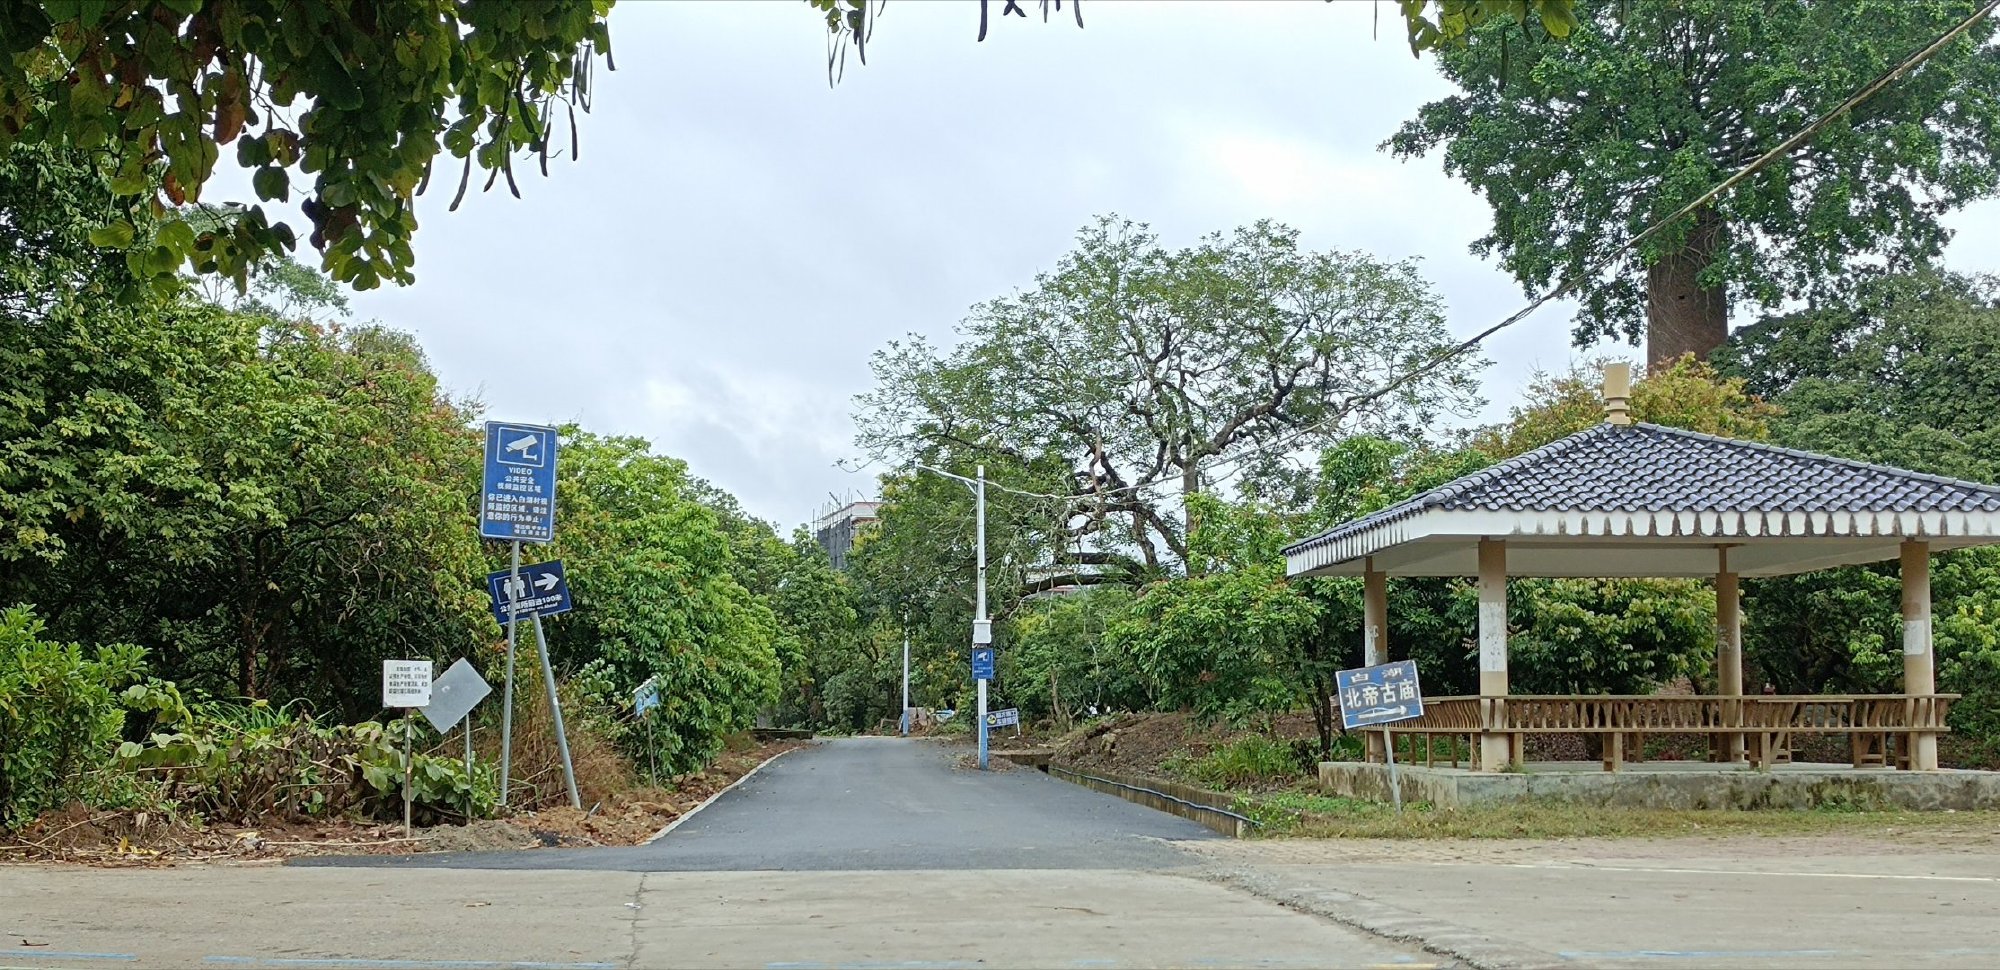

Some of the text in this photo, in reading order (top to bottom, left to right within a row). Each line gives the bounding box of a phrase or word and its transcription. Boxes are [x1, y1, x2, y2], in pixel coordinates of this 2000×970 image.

[504, 475, 535, 484] 公共安全
[497, 482, 541, 493] 视频监控区域
[1345, 679, 1415, 708] 北帝古庙
